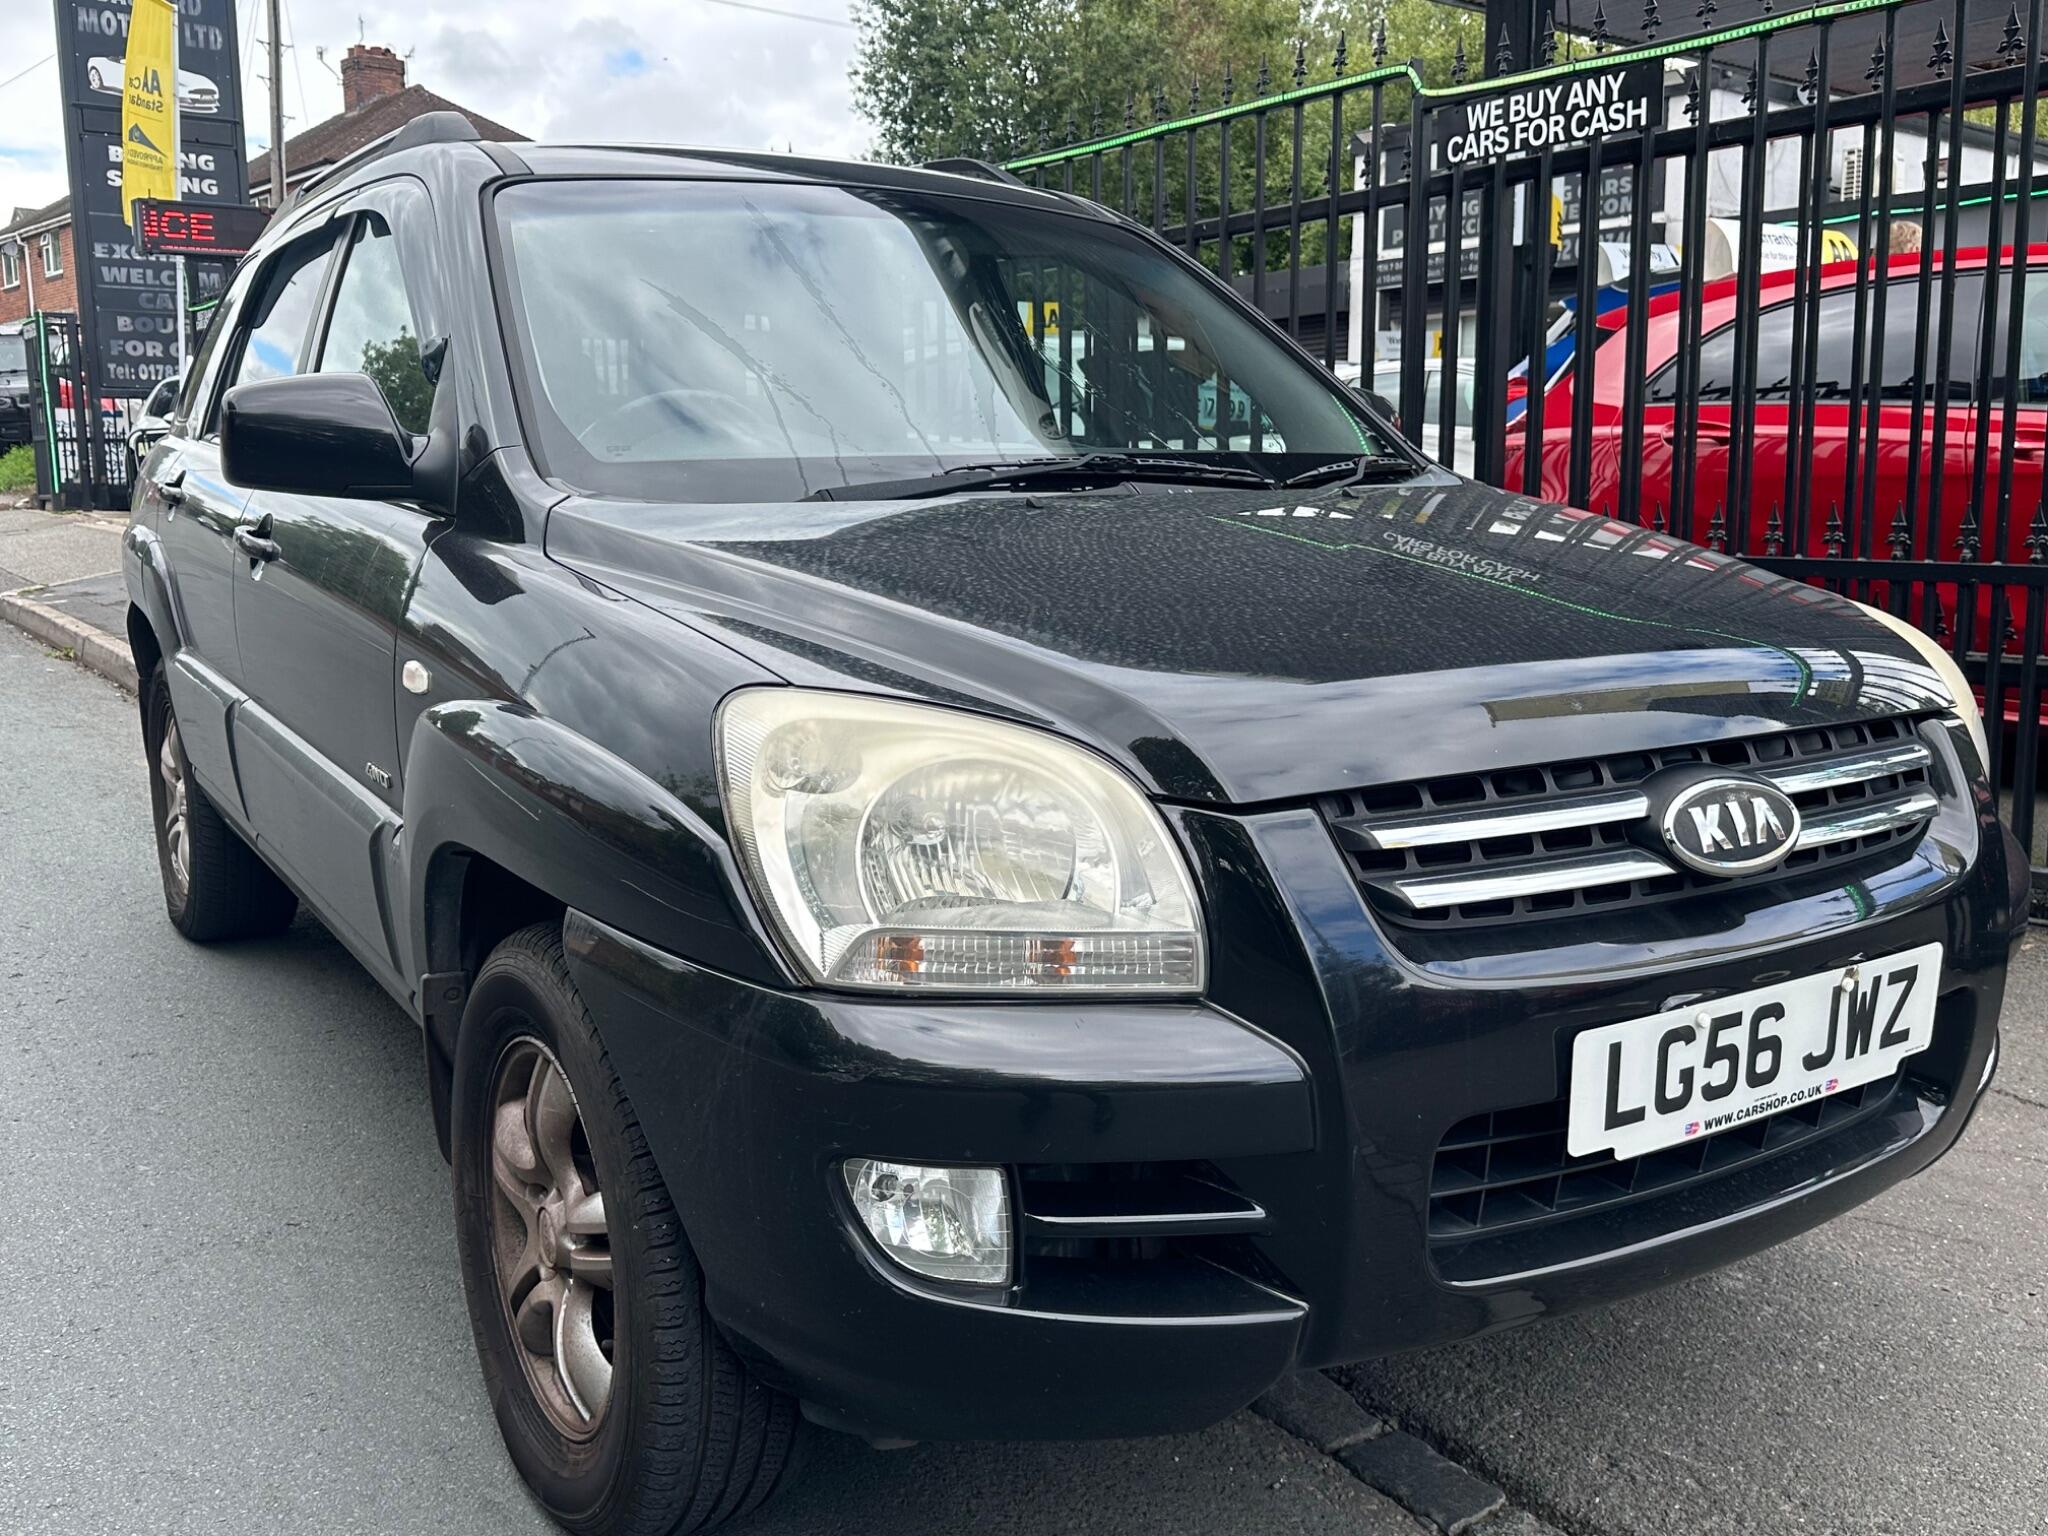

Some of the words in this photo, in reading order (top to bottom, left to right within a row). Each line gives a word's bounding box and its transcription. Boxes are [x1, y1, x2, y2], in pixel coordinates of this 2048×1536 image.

[184, 22, 223, 50] LTD
[1467, 98, 1504, 132] WE
[1509, 85, 1562, 119] BUY
[1566, 71, 1626, 111] ANY
[1447, 126, 1509, 163] CARS
[1515, 114, 1565, 150] FOR
[1570, 97, 1647, 138] CASH
[107, 363, 135, 380] Tel:
[110, 339, 163, 358] FOR
[1687, 796, 1787, 854] KIA
[1604, 1001, 1785, 1131] LG56
[1802, 964, 1920, 1072] JWZ
[1704, 1083, 1823, 1131] WWW.CARSHOP.CO.UK
